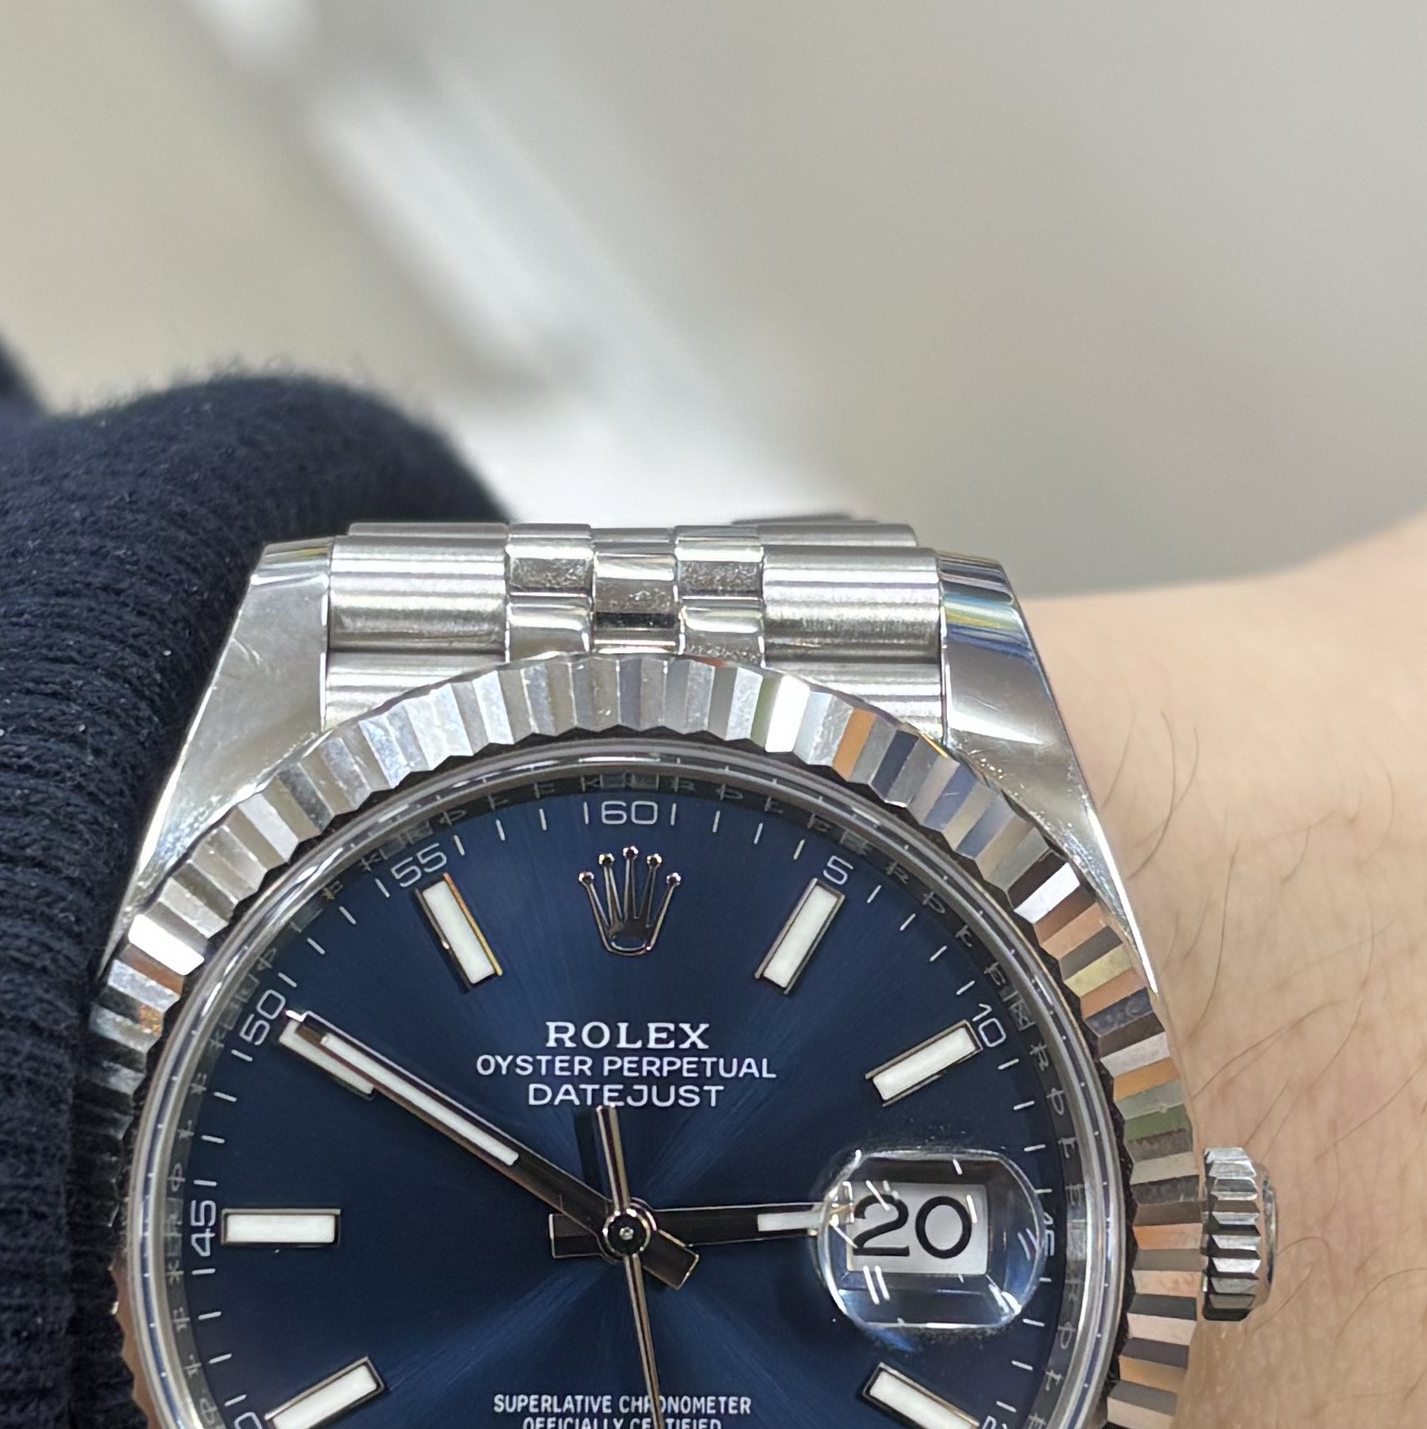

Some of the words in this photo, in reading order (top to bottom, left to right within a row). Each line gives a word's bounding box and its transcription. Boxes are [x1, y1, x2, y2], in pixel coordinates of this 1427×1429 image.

[600, 800, 660, 826] 60
[390, 842, 449, 887] 55
[821, 855, 855, 886] 5
[238, 988, 287, 1047] 50
[972, 1002, 1007, 1048] 10
[545, 1021, 710, 1050] ROLEX
[476, 1054, 593, 1076] OYSTER
[603, 1056, 777, 1079] PERPETUAL
[528, 1083, 725, 1108] DATEJUST
[190, 1199, 217, 1257] 45
[852, 1193, 973, 1260] 20
[493, 1394, 612, 1414] SUPERLATIVE
